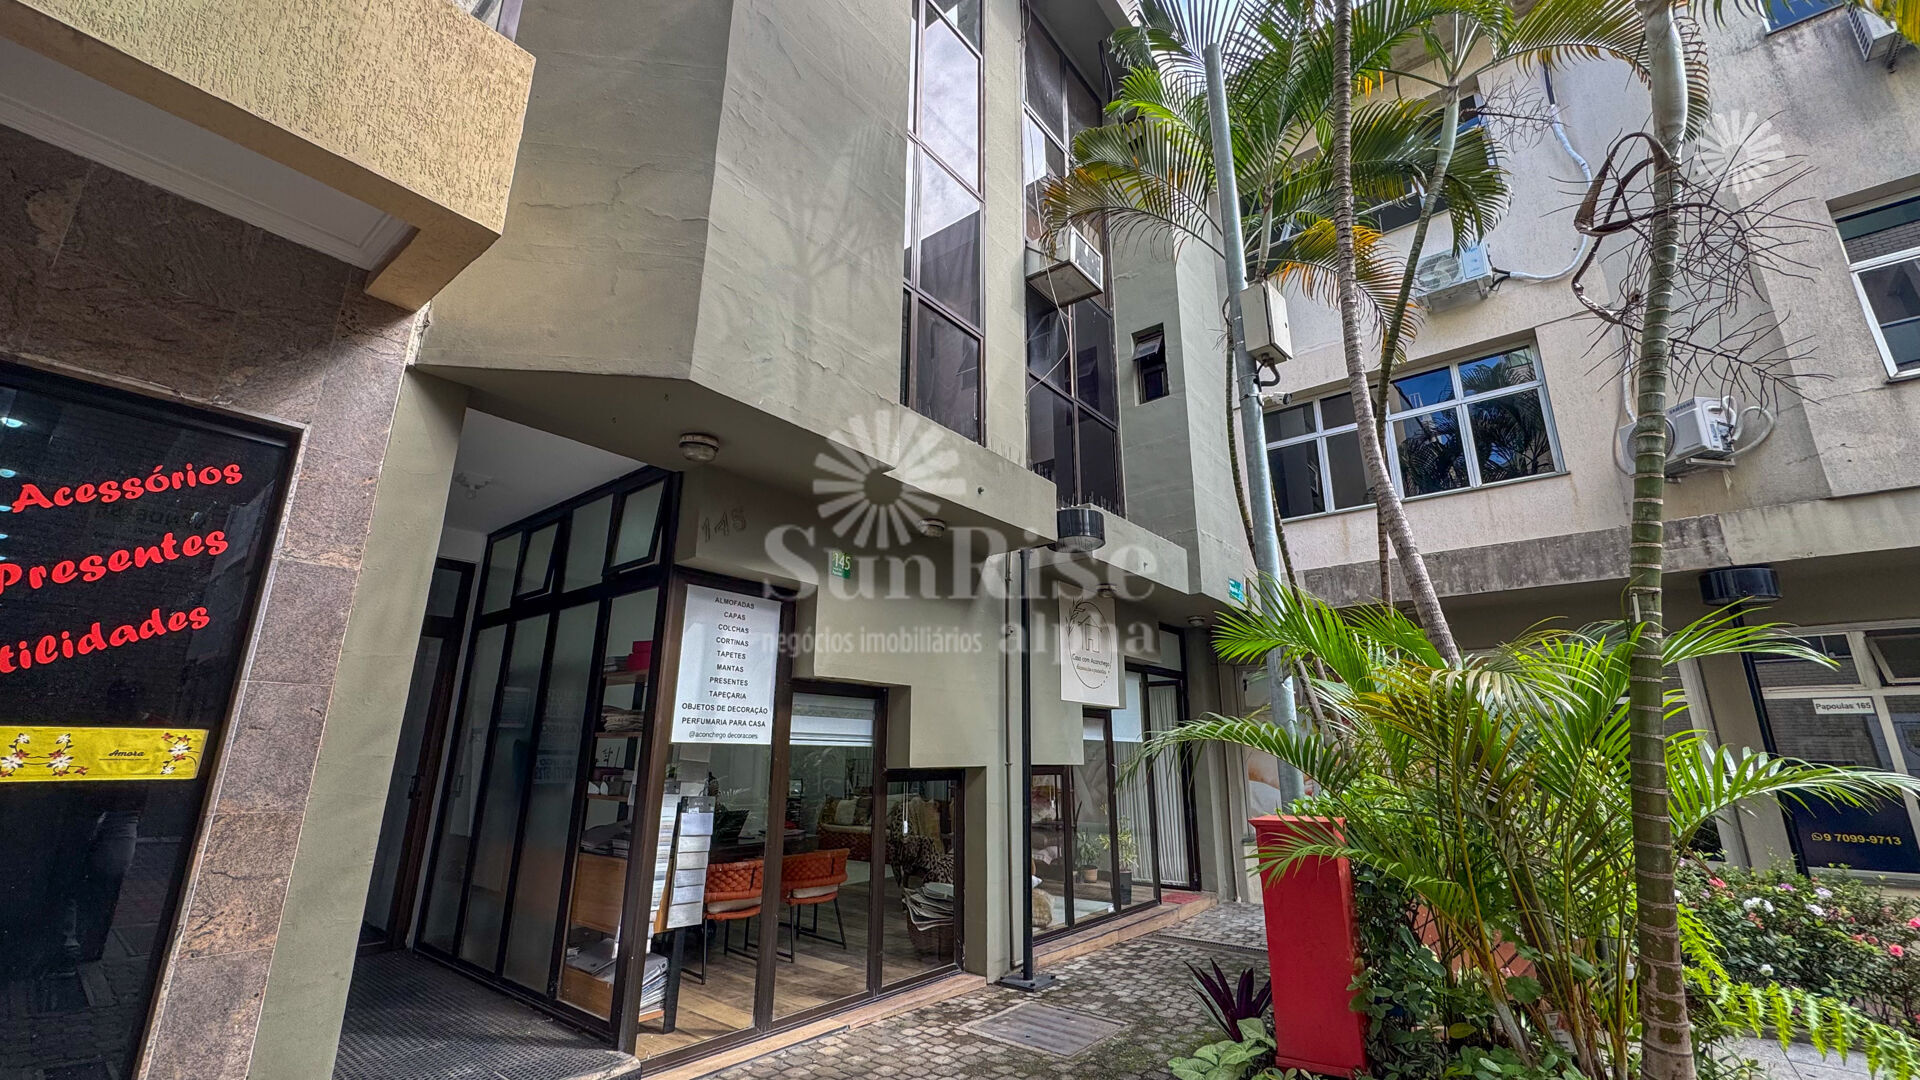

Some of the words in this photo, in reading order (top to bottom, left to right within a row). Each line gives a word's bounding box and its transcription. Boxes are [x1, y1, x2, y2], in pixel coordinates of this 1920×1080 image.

[12, 463, 243, 513] Acessórios
[702, 508, 746, 542] 145
[0, 530, 229, 595] Presentes
[834, 552, 851, 570] 145
[714, 597, 755, 609] ALMOFADAS
[723, 612, 746, 621] CAPAS
[717, 624, 750, 634] COLCHAS
[715, 637, 749, 647] CORTINAS
[716, 651, 746, 660] TAPETES
[716, 664, 744, 673] MANTAS
[709, 677, 749, 687] PRESENTES
[709, 690, 747, 700] TAPEÇARIA
[681, 703, 715, 712] OBJETOS
[716, 704, 725, 712] DE
[727, 704, 769, 715] DECORAÇÃO
[1815, 702, 1854, 711] Papoulas
[681, 717, 728, 726] PERFUMARIA
[728, 719, 747, 727] PARA
[748, 720, 766, 728] CASA
[108, 749, 146, 758] Amora
[1823, 833, 1832, 842] 9
[1834, 833, 1902, 845] 7099-9713
